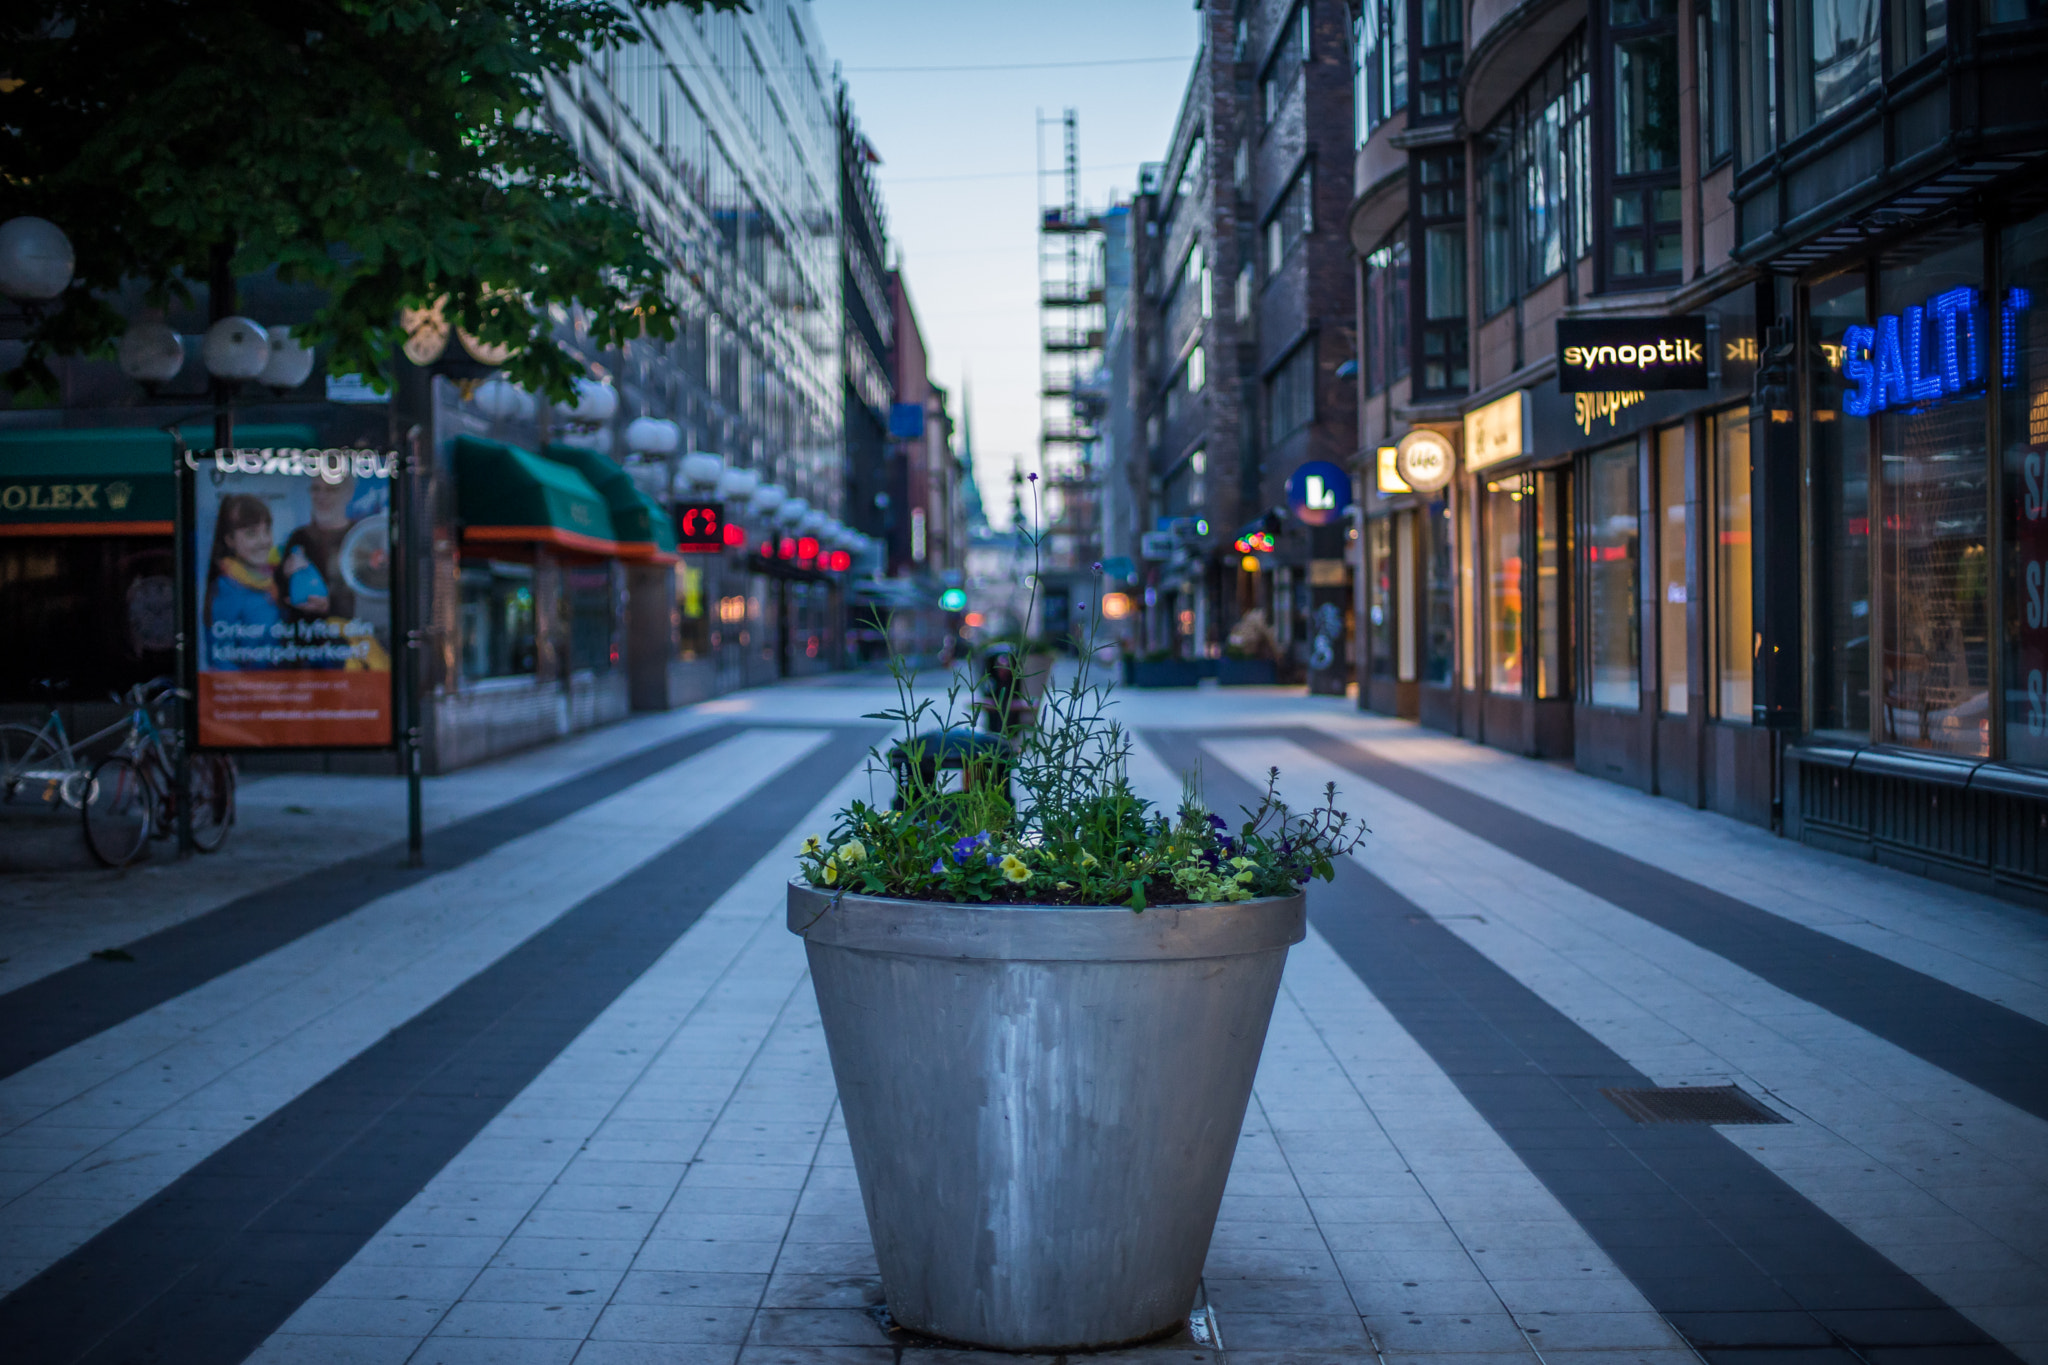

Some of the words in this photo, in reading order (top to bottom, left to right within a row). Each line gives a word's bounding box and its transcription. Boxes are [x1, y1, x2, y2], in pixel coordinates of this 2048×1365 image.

[1564, 339, 1703, 370] synoptik
[0, 484, 99, 510] OLEX
[270, 619, 295, 638] du
[343, 617, 375, 637] din
